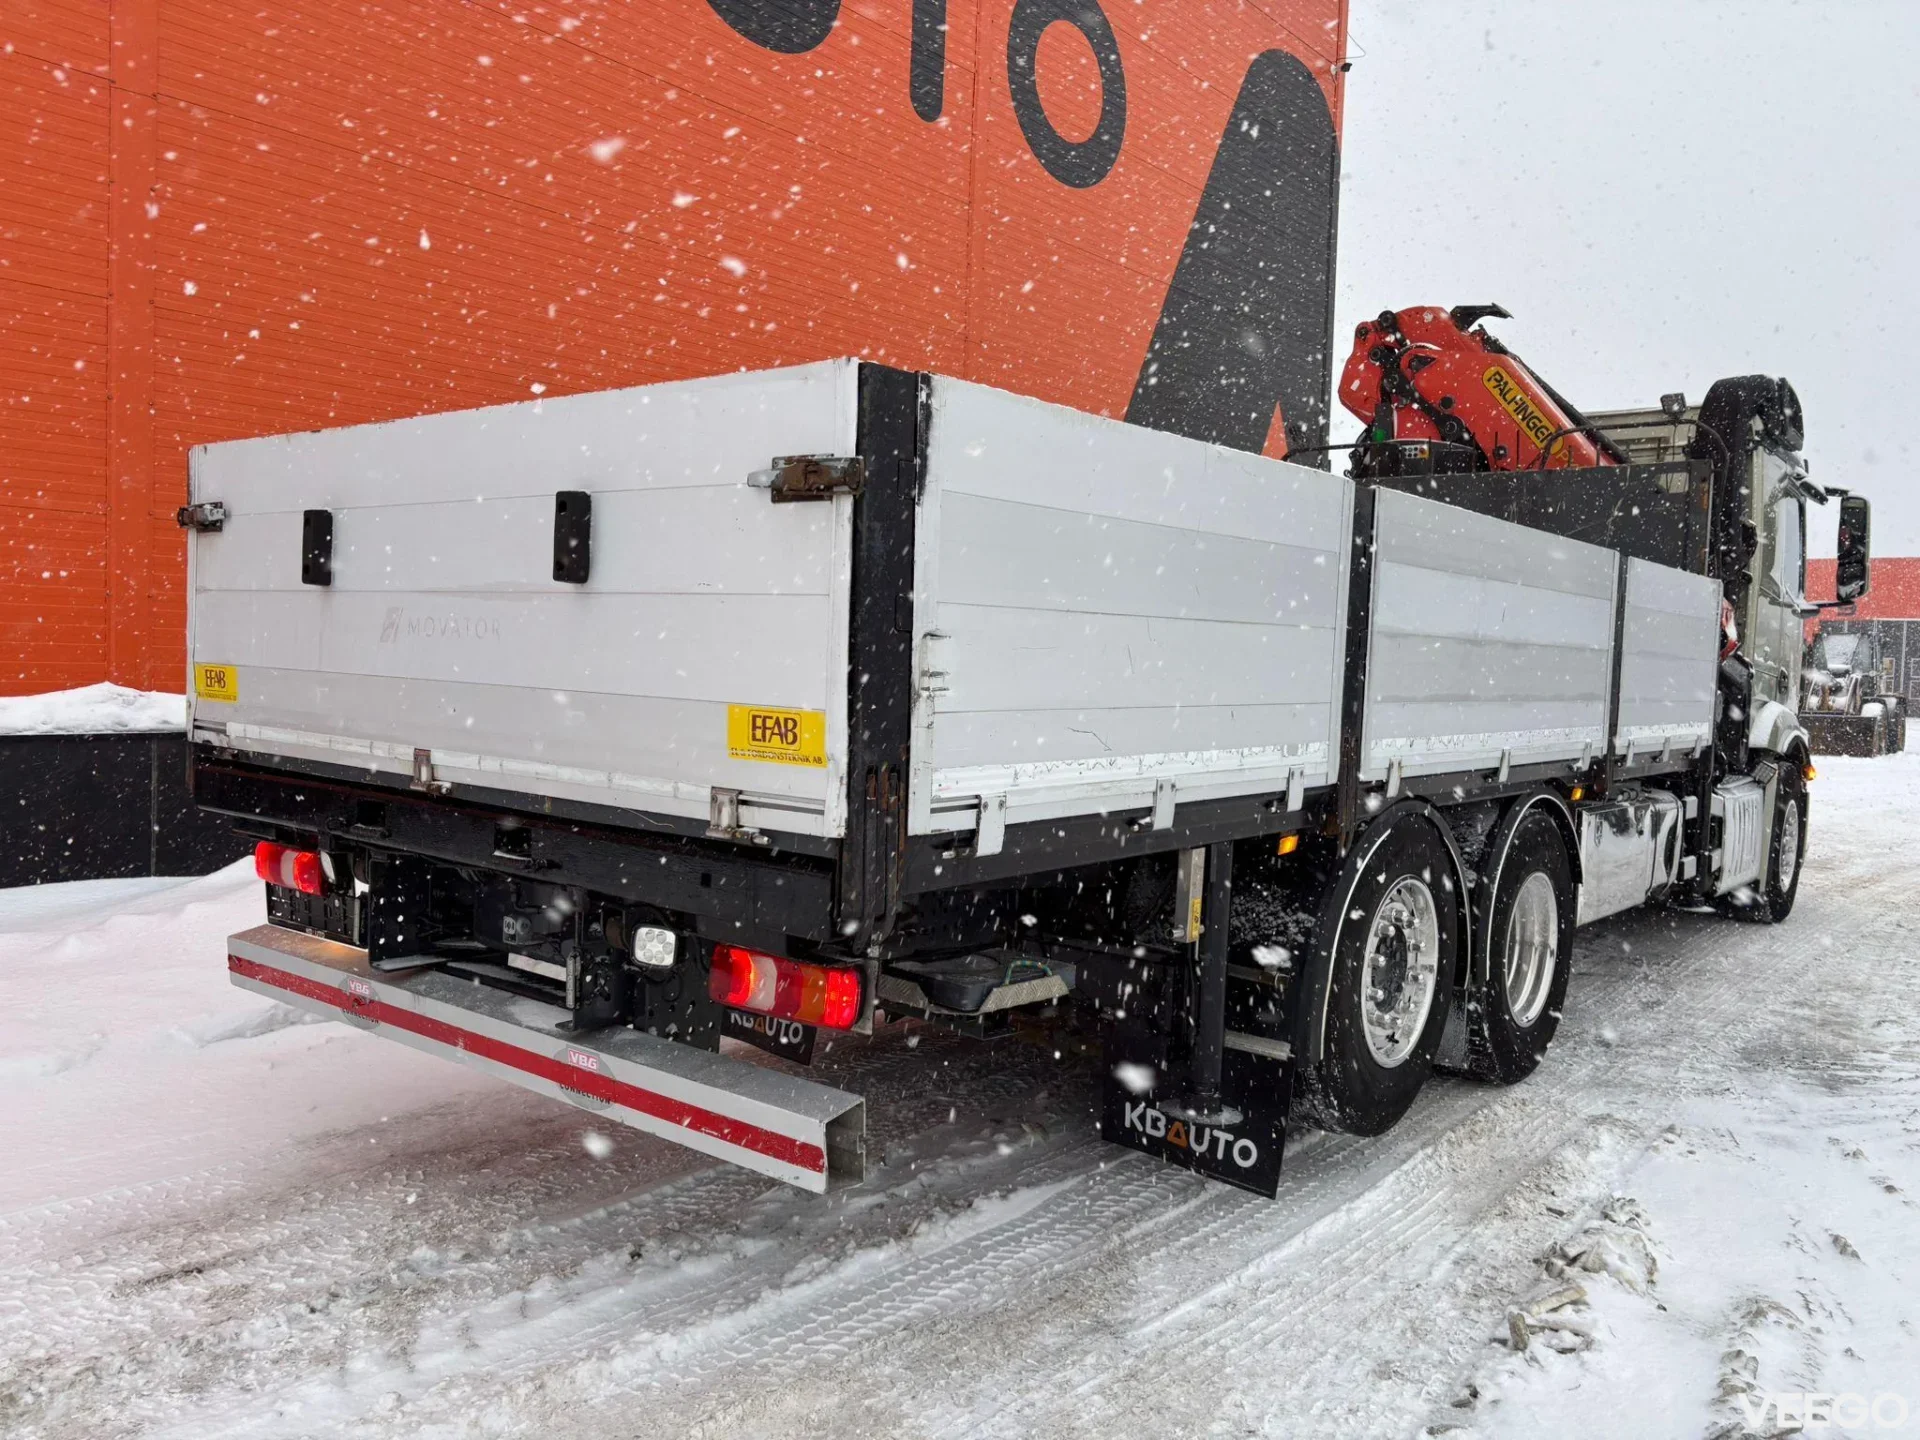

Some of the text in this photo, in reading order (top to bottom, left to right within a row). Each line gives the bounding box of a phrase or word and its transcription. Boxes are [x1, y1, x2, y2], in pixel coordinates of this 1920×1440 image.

[407, 615, 501, 642] MOVATOR
[205, 669, 226, 689] EFAB
[751, 714, 798, 745] EFAB
[812, 756, 823, 765] AB
[570, 1050, 597, 1070] VBG
[1124, 1101, 1258, 1168] KBAUTO
